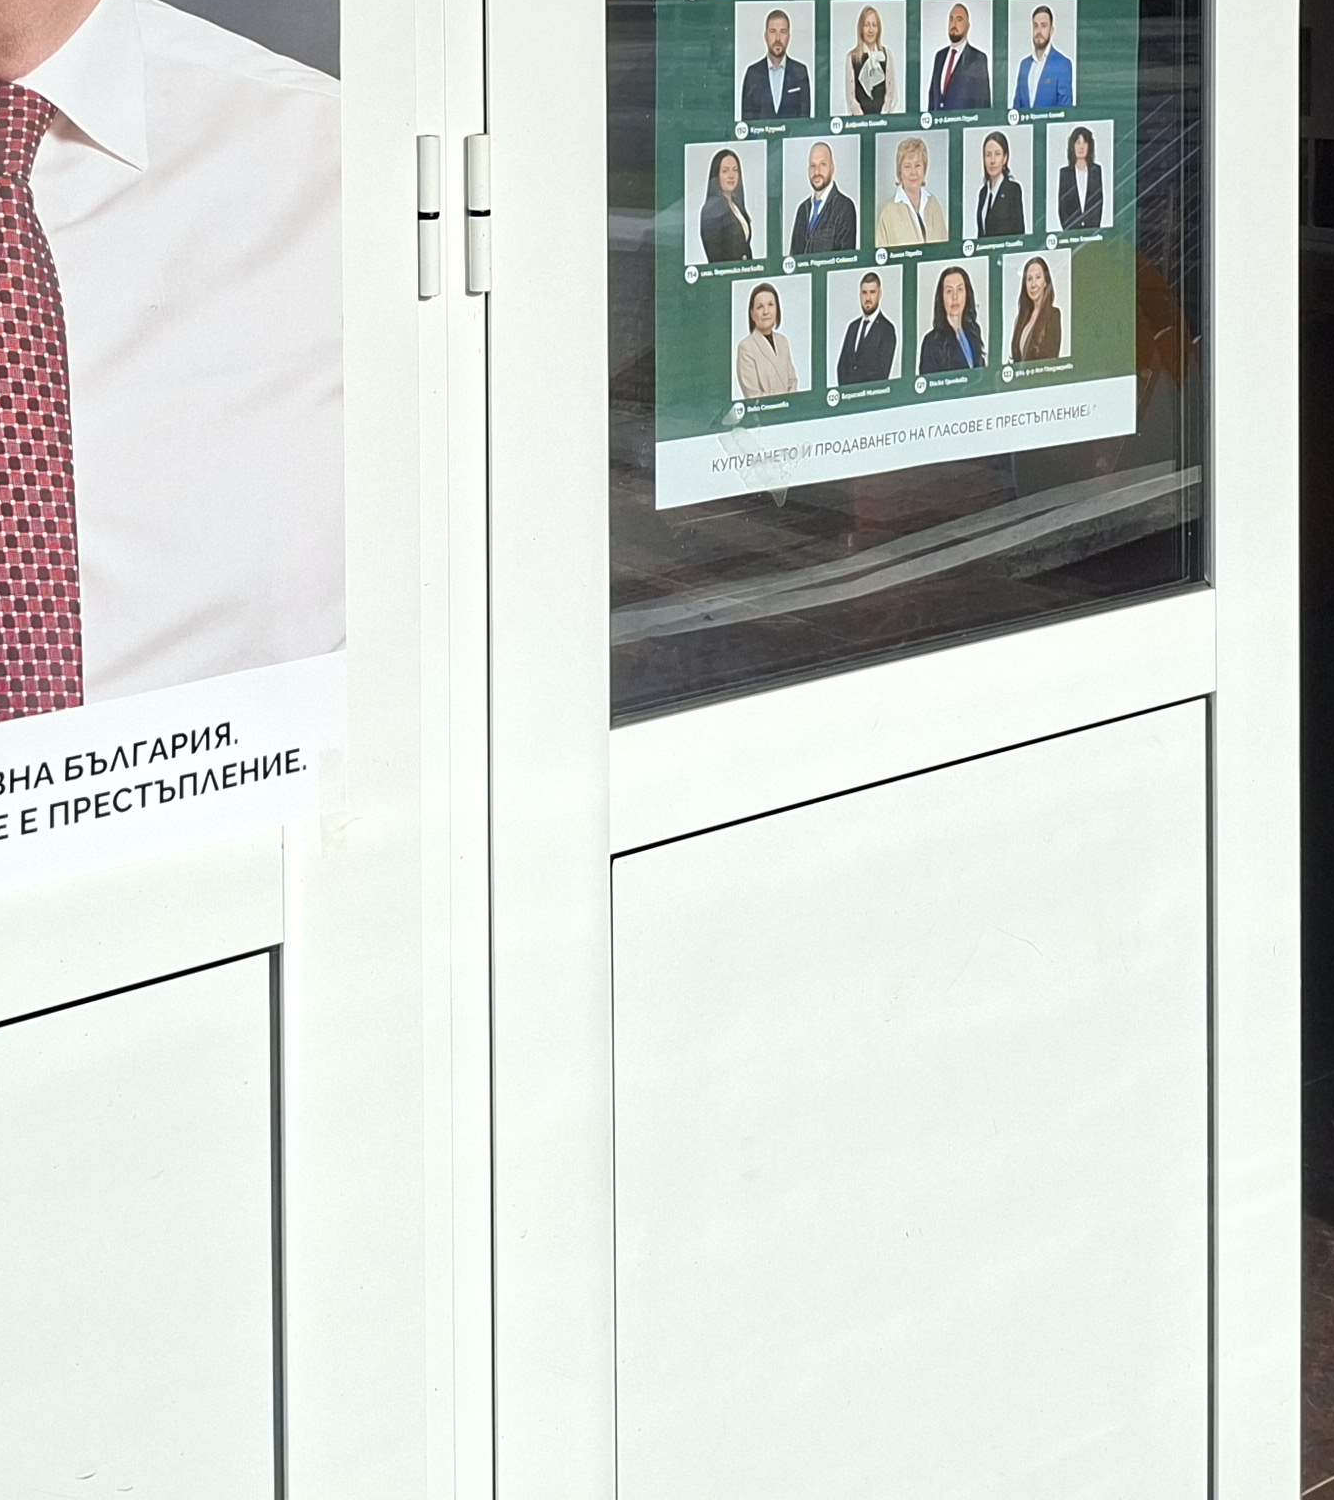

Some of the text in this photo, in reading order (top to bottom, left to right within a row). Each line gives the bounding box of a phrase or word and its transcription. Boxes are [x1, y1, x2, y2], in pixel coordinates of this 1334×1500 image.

[712, 446, 798, 473] КУПУВАНЕТО
[801, 445, 811, 457] И
[815, 430, 907, 457] ПРОДАВАНЕТО
[910, 426, 925, 441] НА
[928, 420, 983, 438] ГЛАСОВЕ
[987, 418, 993, 430] Е
[64, 721, 239, 783] БЪЛГАРИЯ.
[20, 808, 38, 836] Е
[48, 746, 307, 828] ПРЕСТЪПЛЕНИЕ.
